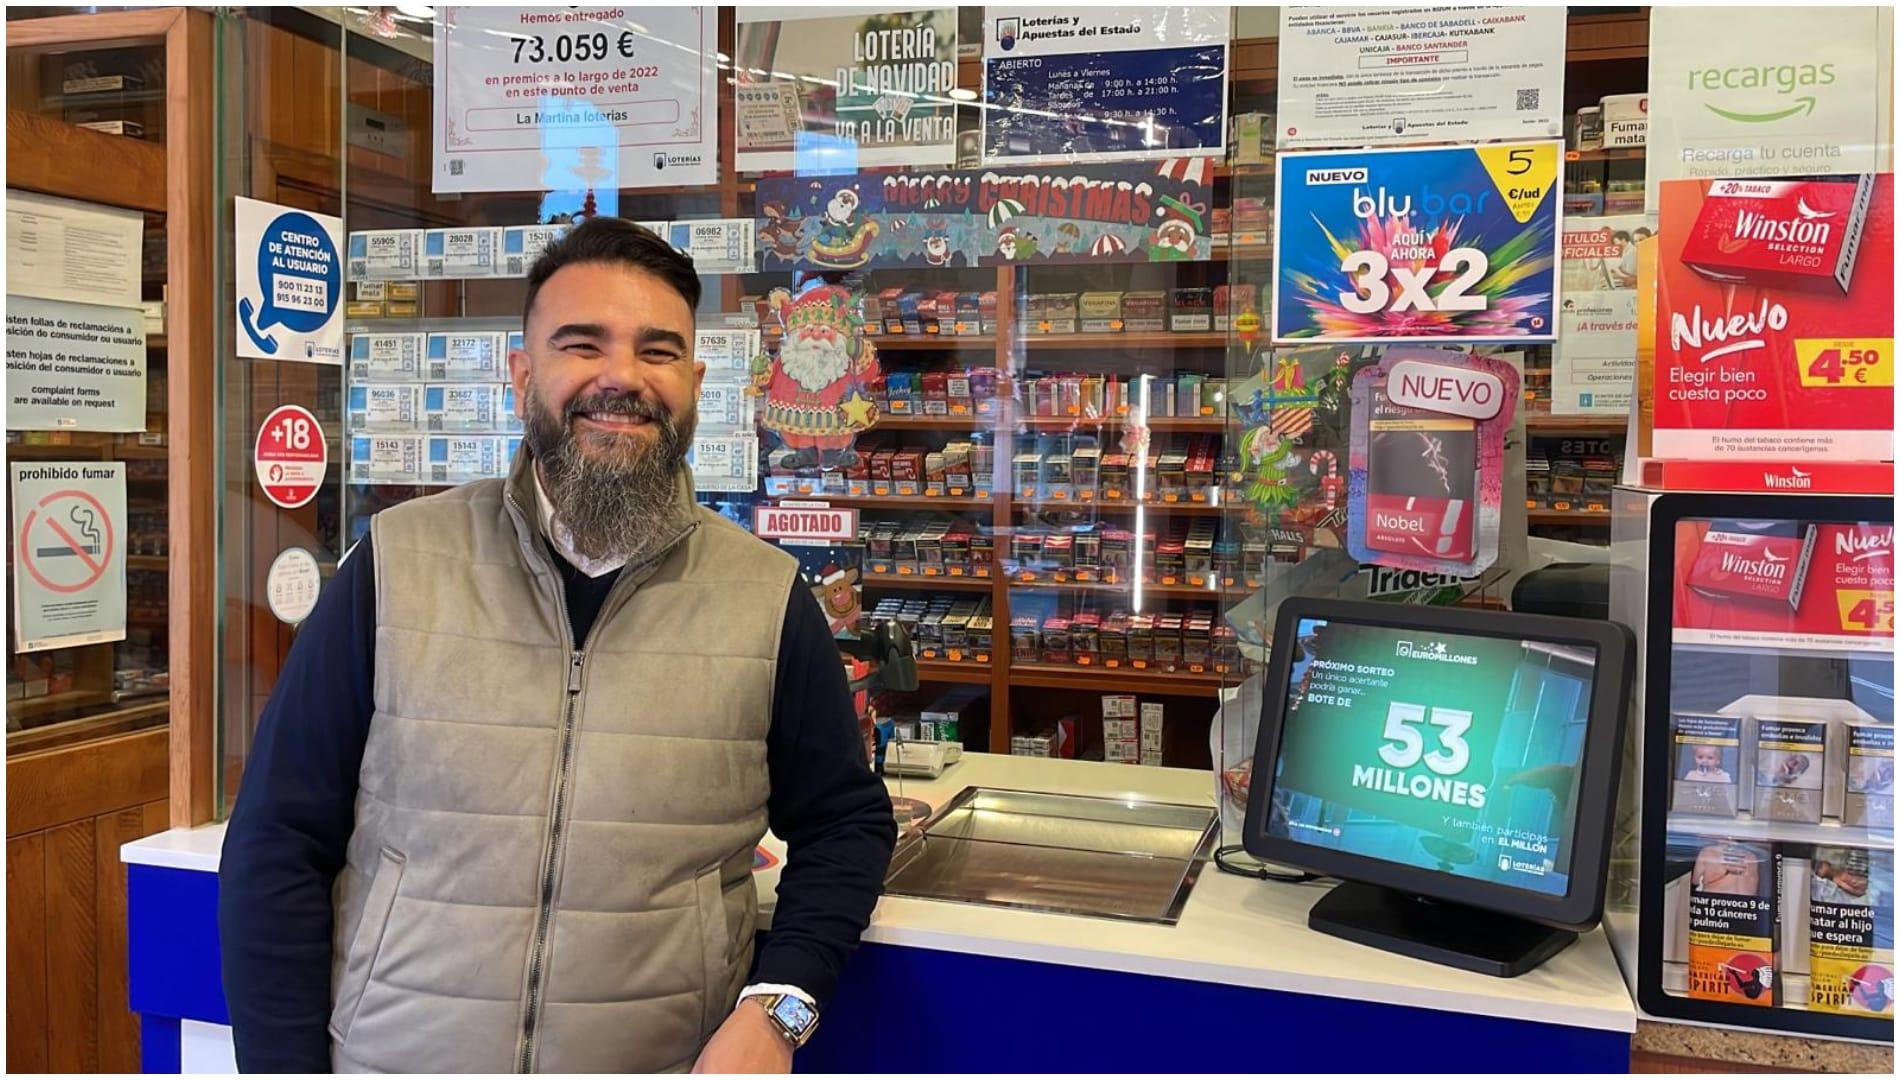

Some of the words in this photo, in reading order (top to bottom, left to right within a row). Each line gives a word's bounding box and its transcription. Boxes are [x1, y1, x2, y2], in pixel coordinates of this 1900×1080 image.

[521, 13, 561, 24] Hemos
[565, 9, 624, 24] entregado
[1023, 17, 1069, 27] Loterías
[1073, 16, 1079, 25] y
[1022, 28, 1074, 41] Apuestas
[1079, 27, 1097, 37] del
[1100, 25, 1141, 35] Estado
[511, 33, 608, 63] 73.059
[617, 32, 634, 58] €
[854, 23, 935, 62] LOTERÍA
[1423, 41, 1468, 50] SANTANDER
[1000, 59, 1042, 70] ABIERTO
[1386, 55, 1440, 65] IMPORTANTE
[486, 76, 499, 86] en
[503, 73, 550, 88] premios
[553, 74, 561, 83] a
[563, 69, 576, 84] lo
[579, 70, 608, 85] largo
[612, 69, 626, 81] de
[630, 67, 658, 78] 2022
[836, 67, 859, 97] DE
[865, 62, 954, 96] NAVIDAD
[1049, 70, 1071, 78] Lunes
[1081, 68, 1111, 77] Viernes
[1689, 63, 1835, 94] recargas
[1105, 79, 1123, 87] 9:00
[1144, 77, 1168, 85] 14:00
[1170, 76, 1178, 84] h.
[506, 88, 520, 98] en
[523, 87, 548, 97] este
[552, 85, 586, 98] punto
[590, 84, 604, 95] de
[608, 83, 639, 94] venta
[1102, 89, 1124, 97] 17:00
[1127, 88, 1136, 96] h.
[1146, 86, 1168, 95] 21:00
[517, 113, 531, 124] La
[535, 111, 580, 124] Martina
[861, 121, 871, 144] A
[876, 120, 895, 143] LA
[903, 116, 953, 141] VENTA
[1615, 135, 1645, 144] mata
[1682, 148, 1753, 164] Recarga
[1760, 146, 1776, 159] tu
[1782, 145, 1840, 159] cuenta
[1507, 149, 1535, 176] 5
[1309, 171, 1365, 182] NUEVO
[1508, 188, 1540, 200] €/ud
[1744, 185, 1771, 193] TABACO
[883, 175, 970, 205] MERRY
[980, 172, 1153, 225] CHRISTMAS
[696, 227, 722, 236] 06982
[1735, 209, 1830, 244] Winston
[281, 231, 319, 246] CENTRO
[1393, 231, 1425, 246] AQUÍ
[1427, 233, 1436, 245] Y
[269, 242, 282, 253] DE
[285, 246, 331, 262] ATENCIÓN
[1391, 247, 1436, 260] AHORA
[1768, 243, 1824, 254] SELECTION
[272, 257, 286, 269] AL
[287, 259, 328, 275] USUARIO
[1779, 253, 1822, 268] LARGO
[278, 280, 294, 290] 900
[296, 281, 302, 292] 11
[305, 282, 313, 293] 23
[315, 284, 323, 294] 13
[1340, 248, 1488, 315] 3x2
[277, 293, 289, 302] 915
[292, 295, 301, 304] 96
[303, 296, 312, 305] 23
[314, 297, 324, 307] 00
[1671, 298, 1789, 351] Nuevo
[700, 336, 726, 345] 57635
[1670, 368, 1717, 383] Elegir
[1720, 367, 1755, 383] bien
[1855, 368, 1867, 383] €
[32, 385, 75, 396] complaint
[77, 386, 100, 396] forms
[1401, 374, 1492, 405] NUEVO
[1669, 388, 1720, 401] cuesta
[1723, 388, 1767, 404] poco
[14, 396, 28, 404] are
[31, 397, 69, 406] available
[72, 398, 82, 407] on
[84, 400, 115, 408] request
[271, 418, 310, 450] +18
[376, 441, 398, 449] 15143
[20, 467, 78, 481] prohibido
[82, 467, 115, 479] fumar
[1765, 472, 1811, 488] Winston
[767, 514, 841, 532] AGOTADO
[1376, 513, 1425, 533] Nobel
[1271, 528, 1304, 543] HALLS
[1721, 552, 1785, 578] Winston
[1836, 563, 1865, 576] Elegir
[1867, 563, 1890, 575] bien
[1744, 576, 1782, 585] SELECTION
[1412, 650, 1478, 665] EUROMILLONES
[1313, 659, 1355, 672] PRÓXIMO
[1357, 666, 1395, 677] SORTEO
[1312, 671, 1323, 679] Un
[1326, 673, 1347, 682] único
[1349, 677, 1389, 688] acertante
[1308, 693, 1335, 705] BOTE
[1337, 697, 1352, 707] DE
[1377, 701, 1474, 776] 53
[1351, 763, 1488, 808] MILLONES
[1442, 816, 1450, 826] Y
[1453, 818, 1493, 833] también
[1497, 827, 1548, 844] participas
[1482, 836, 1494, 845] en
[1498, 837, 1510, 846] EL
[1511, 840, 1548, 854] MILLÓN
[1694, 919, 1729, 928] pulmón
